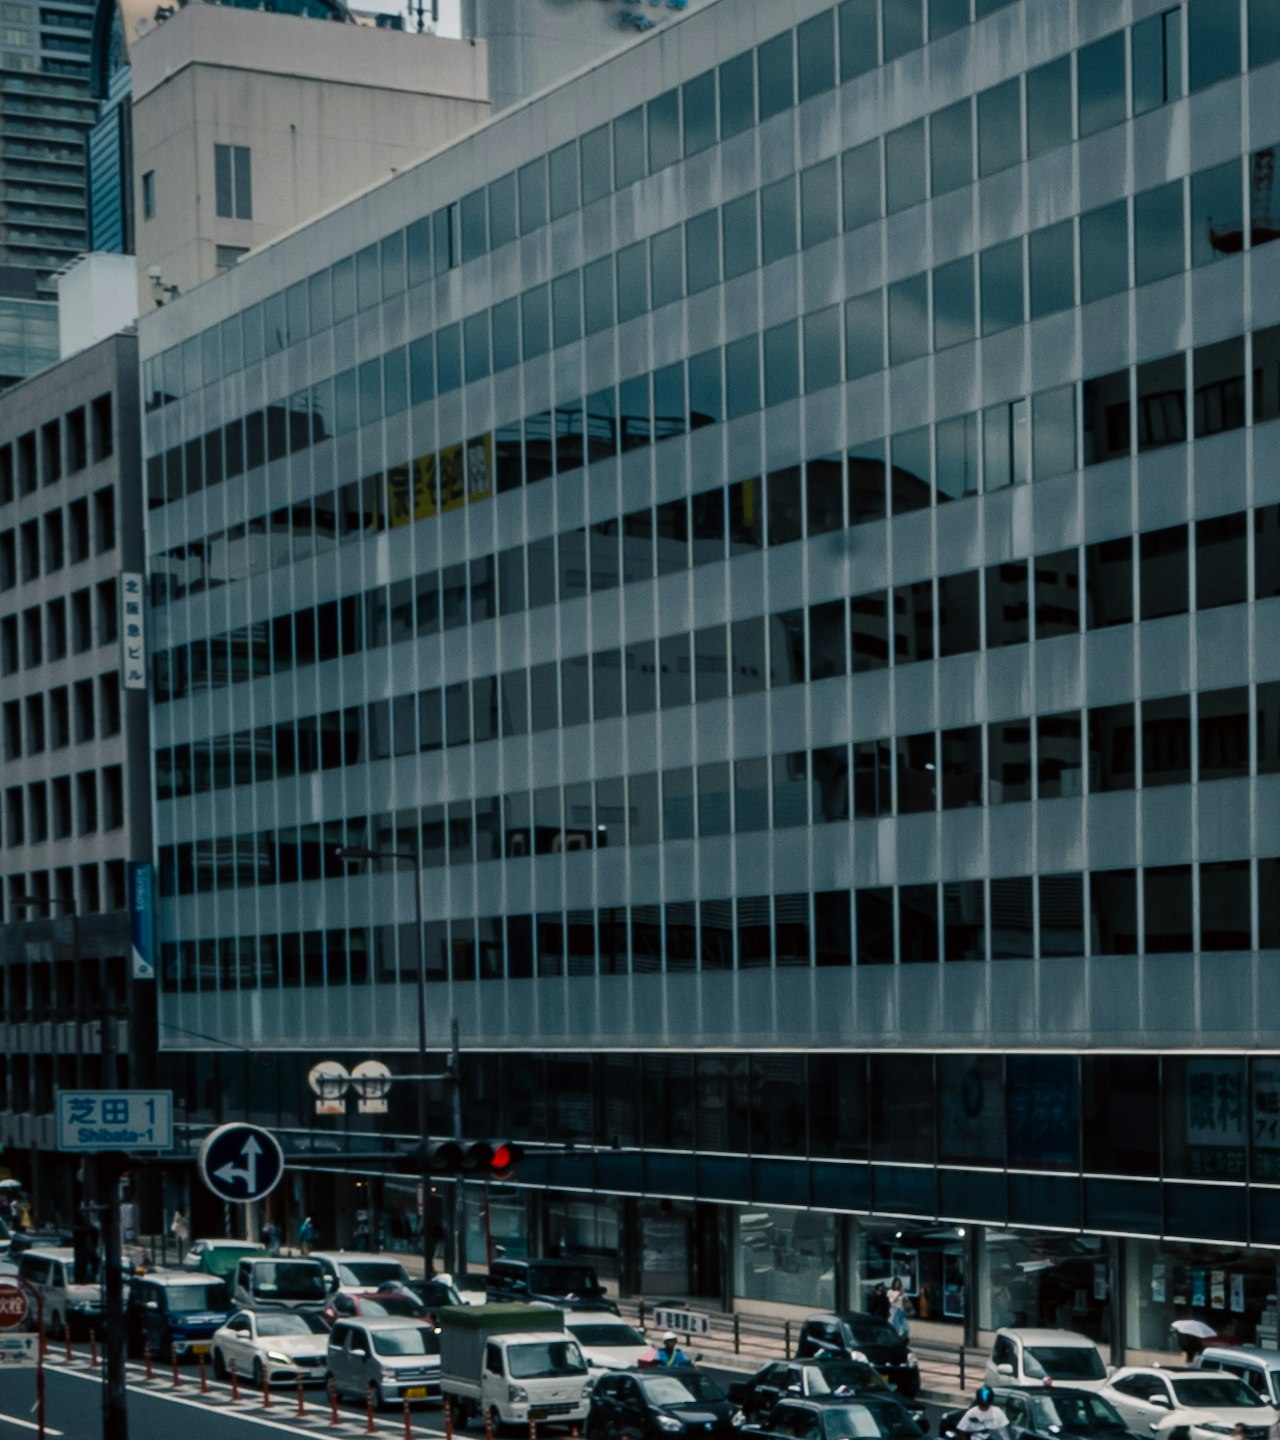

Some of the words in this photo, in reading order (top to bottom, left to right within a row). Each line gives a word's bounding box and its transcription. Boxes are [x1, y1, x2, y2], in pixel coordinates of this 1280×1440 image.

[67, 1097, 129, 1125] 芝田
[145, 1097, 156, 1125] 1
[78, 1128, 154, 1144] Shibata-1
